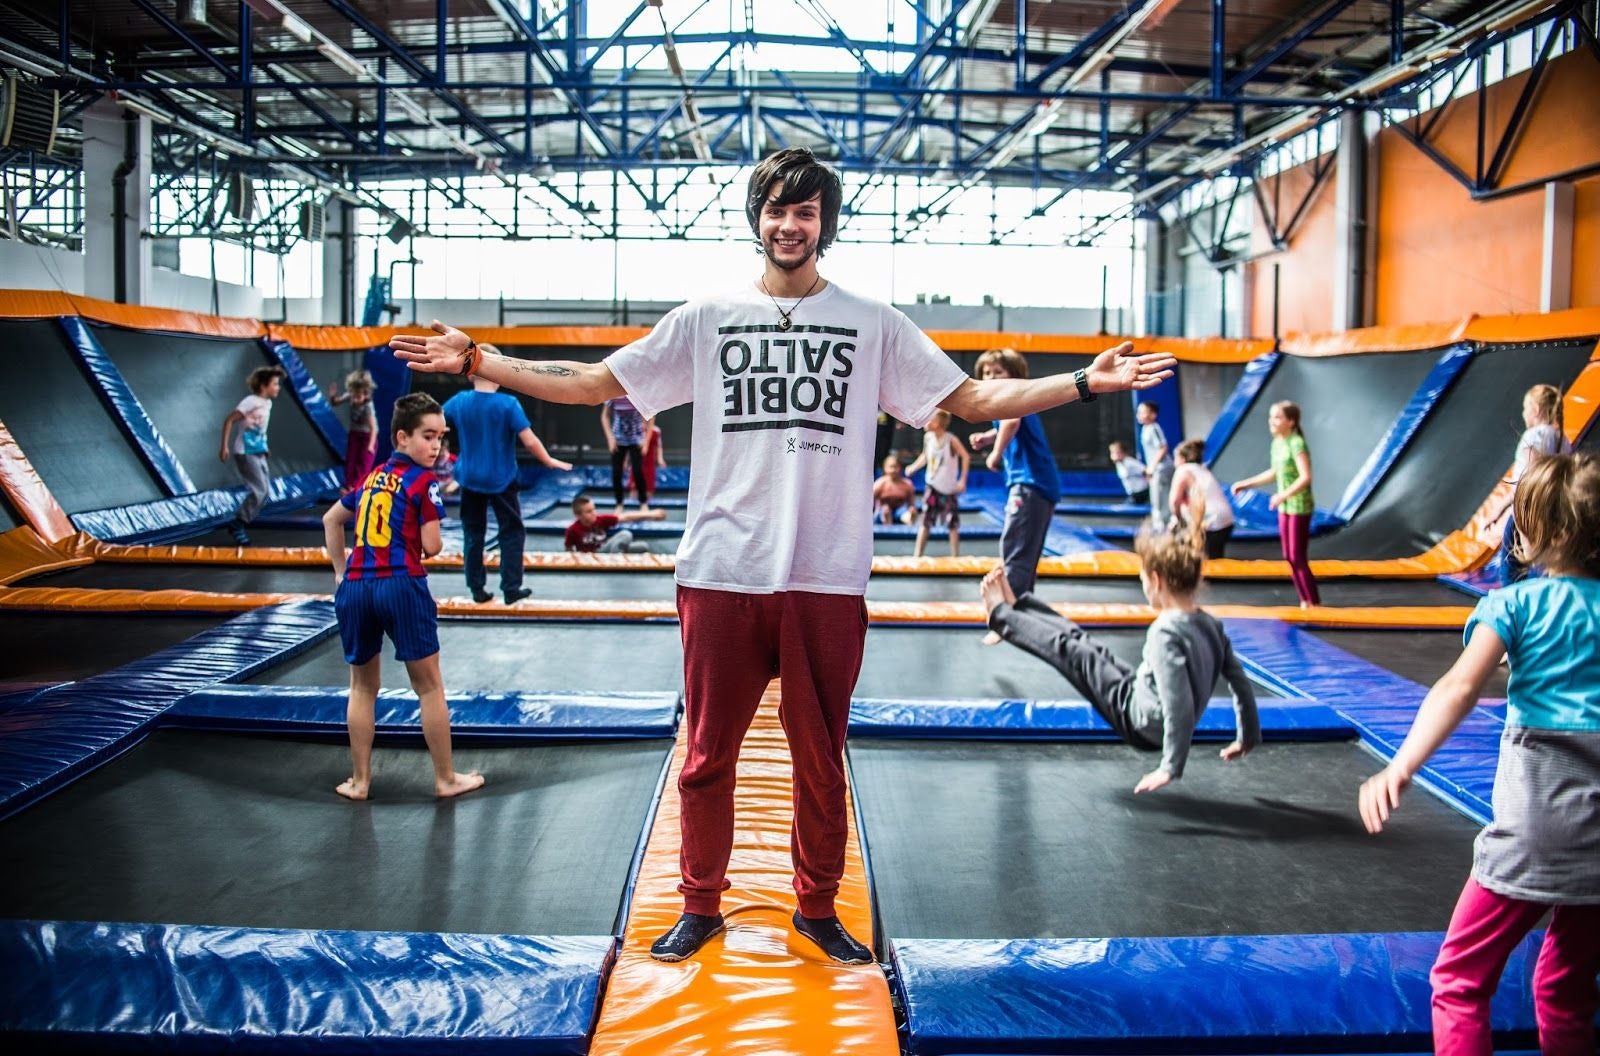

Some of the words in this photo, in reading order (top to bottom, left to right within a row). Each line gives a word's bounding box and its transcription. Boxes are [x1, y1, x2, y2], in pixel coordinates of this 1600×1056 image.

[720, 339, 856, 377] SALTO
[798, 440, 842, 456] JUMPCITY
[356, 489, 392, 548] 10
